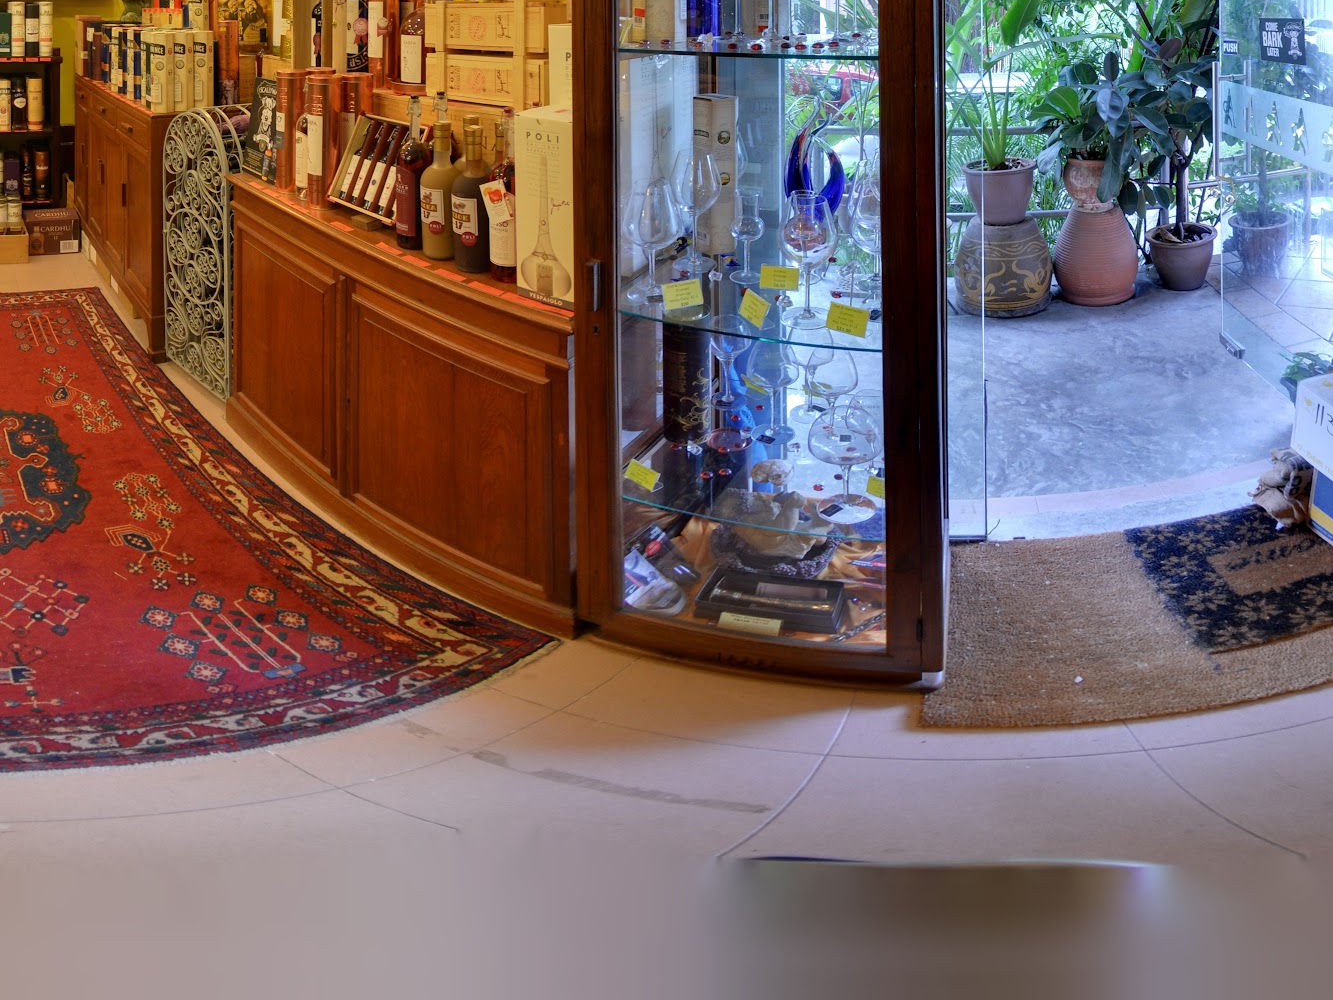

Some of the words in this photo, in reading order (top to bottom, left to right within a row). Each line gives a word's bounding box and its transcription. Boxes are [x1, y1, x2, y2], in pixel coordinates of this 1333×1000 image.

[1262, 31, 1283, 48] BARK
[1223, 43, 1238, 53] PUSH
[1266, 47, 1280, 57] LATER
[527, 131, 560, 144] POLI
[40, 225, 73, 234] CARDHU
[529, 291, 563, 306] VESPAIOLO
